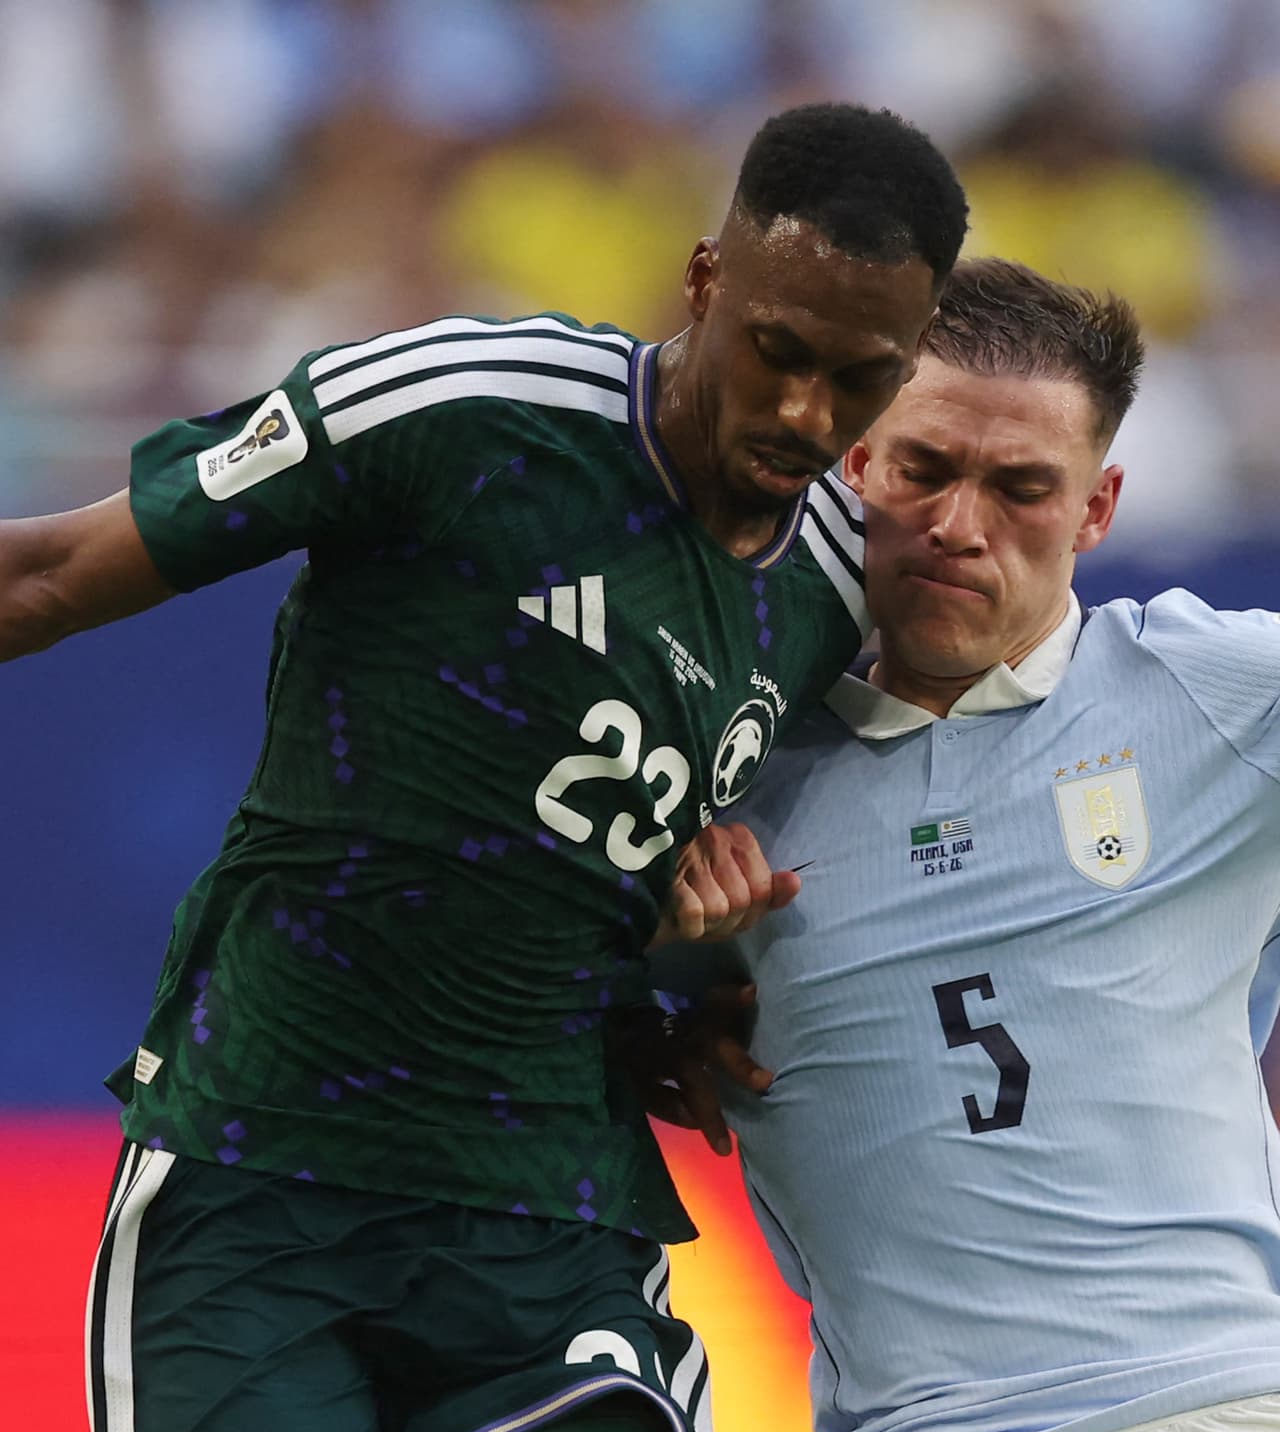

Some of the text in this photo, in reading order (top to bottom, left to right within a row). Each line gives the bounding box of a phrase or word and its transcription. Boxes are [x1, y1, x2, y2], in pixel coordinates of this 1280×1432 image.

[535, 699, 691, 872] 23
[952, 838, 974, 855] USA
[931, 972, 1031, 1135] 5
